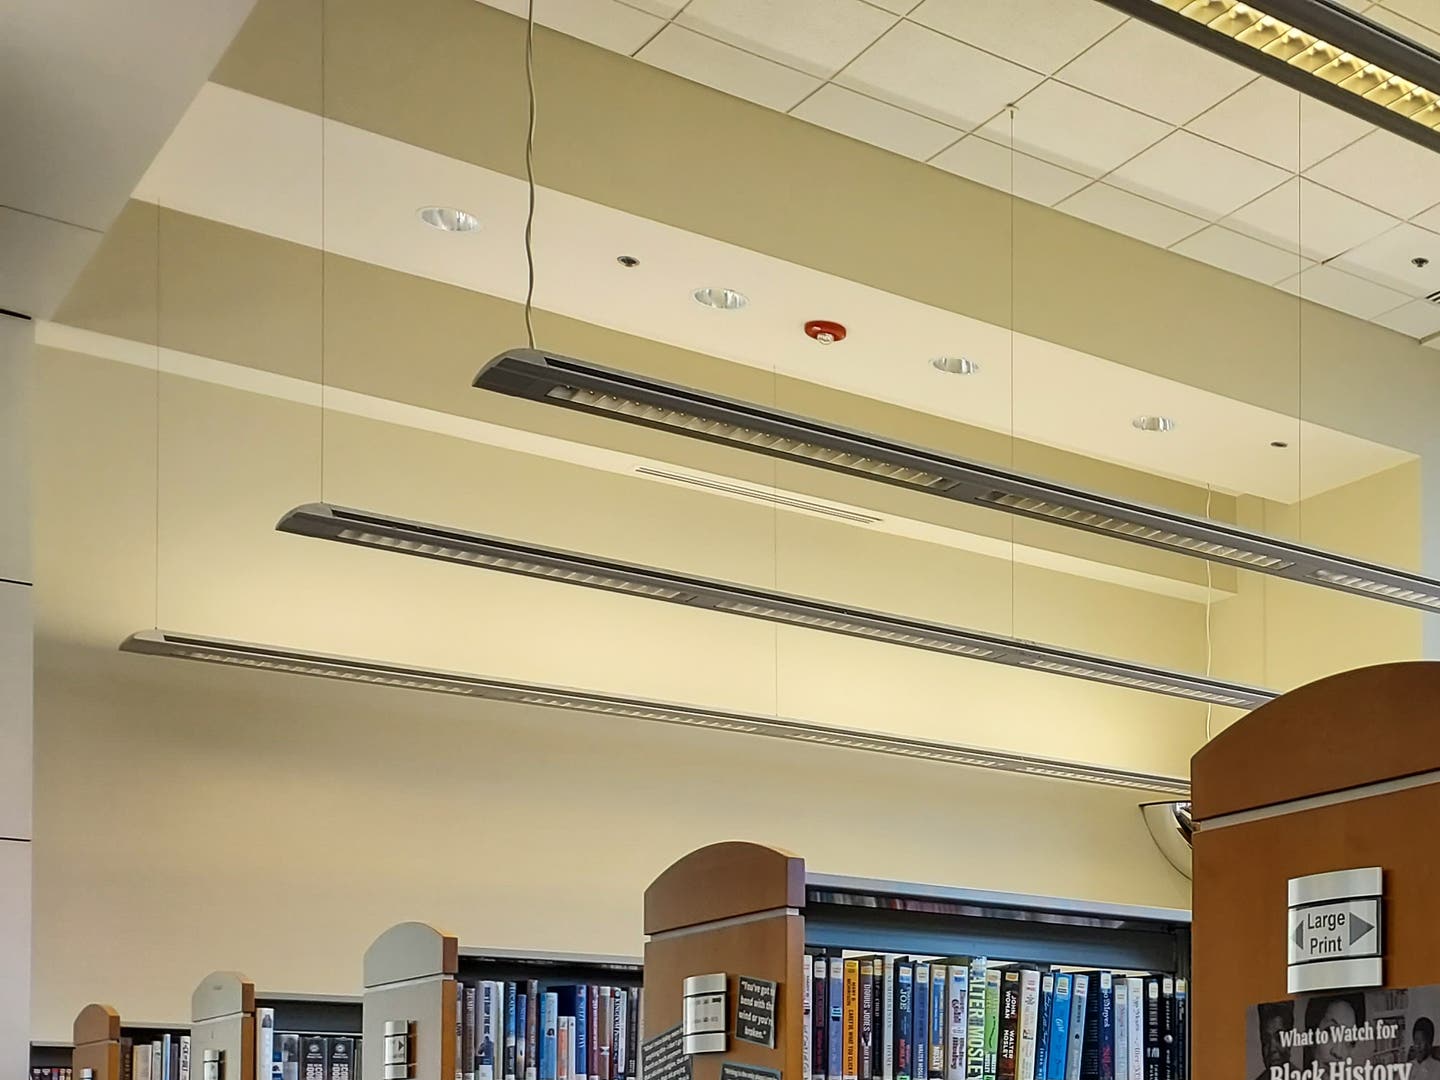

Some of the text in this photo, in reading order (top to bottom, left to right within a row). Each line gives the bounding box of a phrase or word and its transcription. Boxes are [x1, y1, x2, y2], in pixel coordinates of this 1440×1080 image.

[1307, 912, 1346, 932] Large
[1310, 936, 1343, 955] Print
[754, 998, 766, 1009] with
[899, 989, 907, 1010] JOE
[863, 1009, 871, 1032] JONES
[967, 977, 985, 1080] ALTER MOSLEY
[1279, 1019, 1399, 1048] What to Watch for
